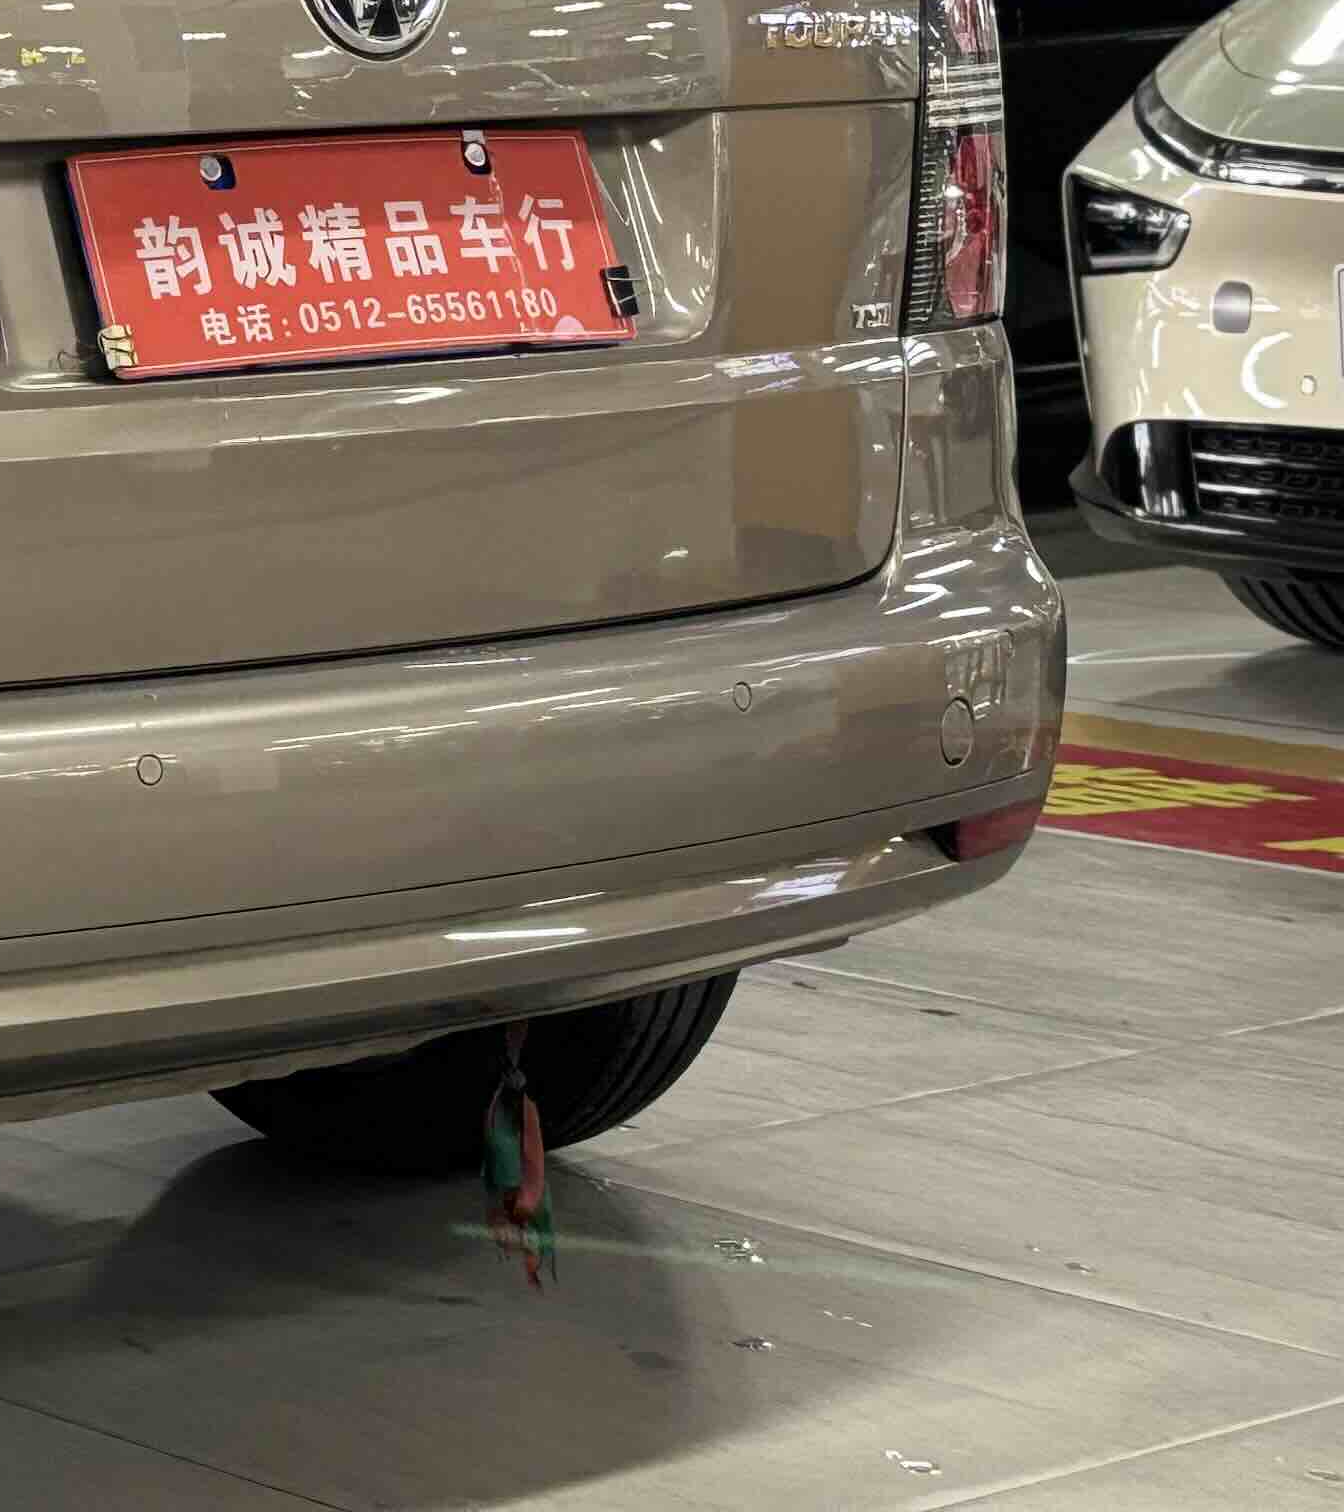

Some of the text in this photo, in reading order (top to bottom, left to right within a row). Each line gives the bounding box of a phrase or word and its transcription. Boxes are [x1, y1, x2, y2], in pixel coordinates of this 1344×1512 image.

[132, 192, 577, 301] 韵诚精品车行
